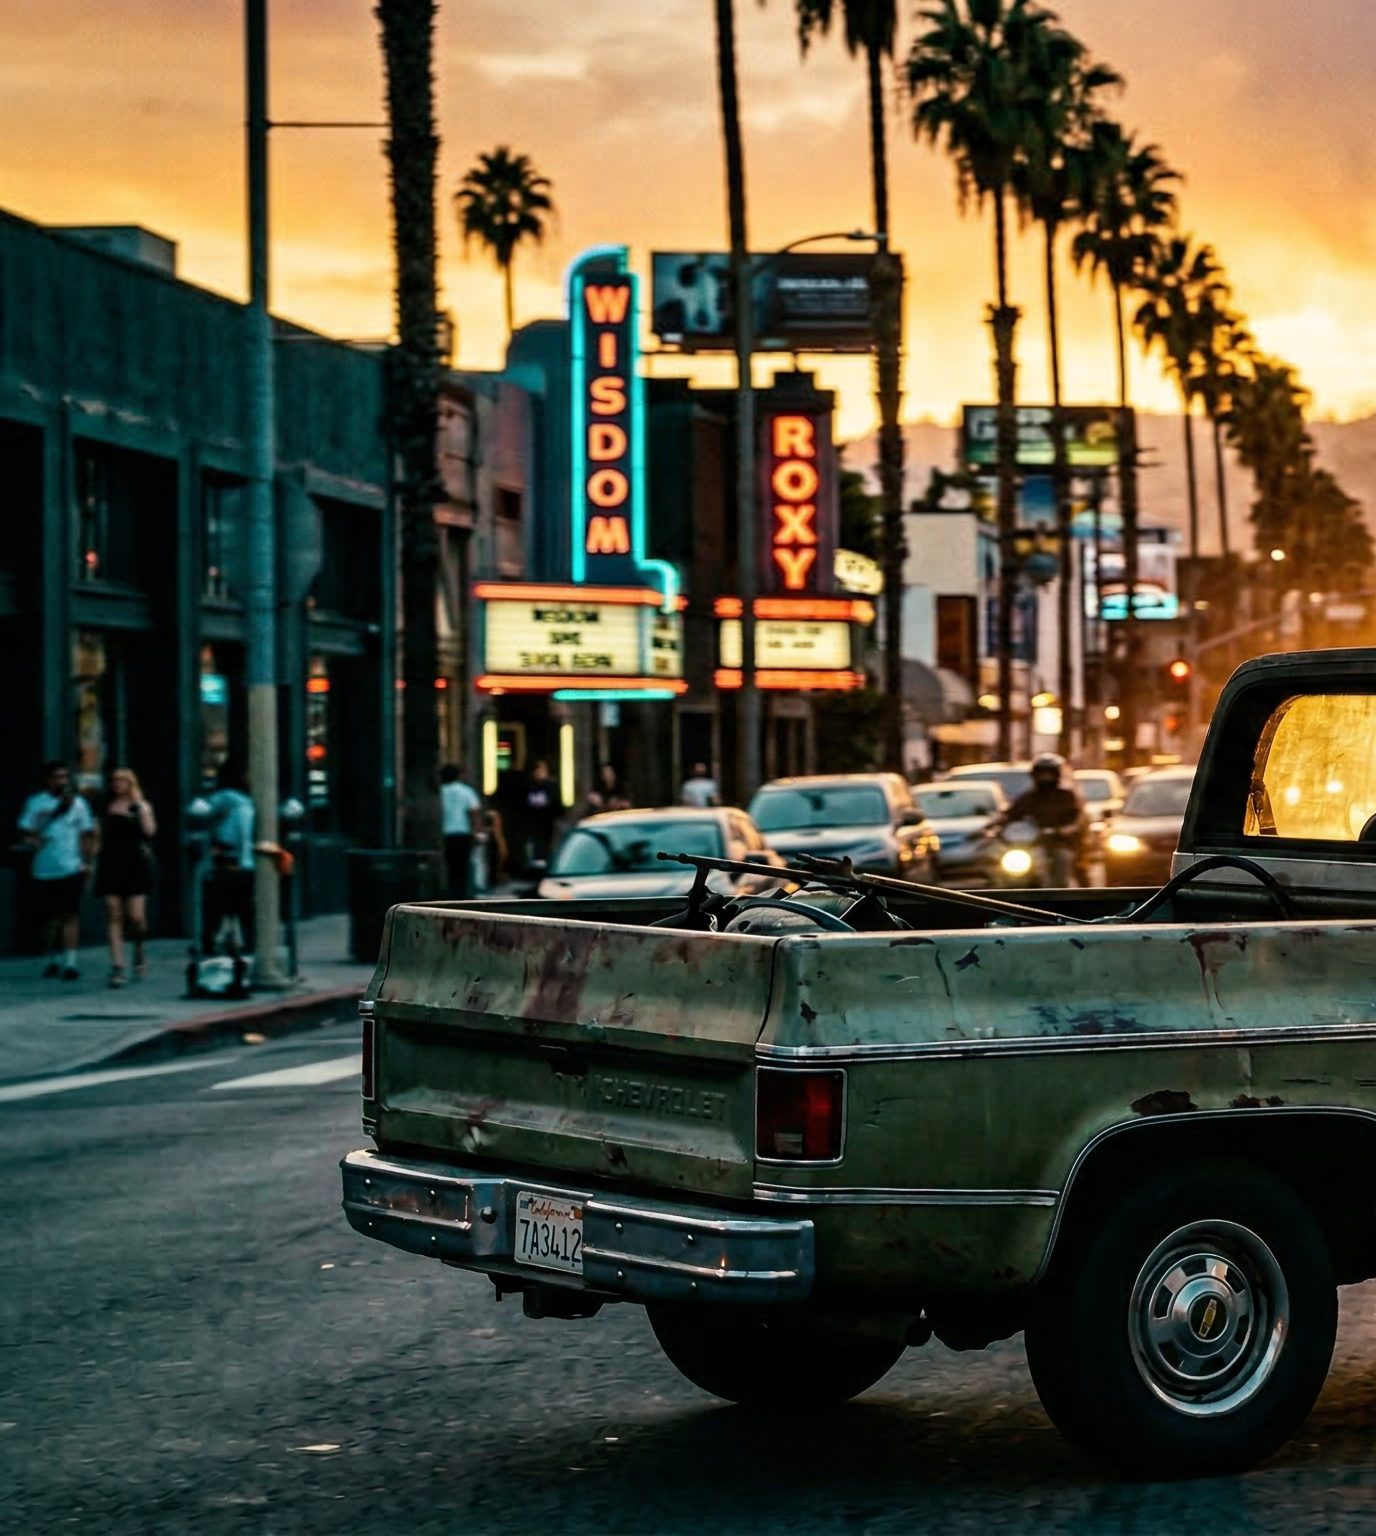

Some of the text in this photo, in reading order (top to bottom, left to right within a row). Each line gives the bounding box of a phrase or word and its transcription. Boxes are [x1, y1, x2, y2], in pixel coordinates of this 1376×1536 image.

[584, 285, 631, 554] WISDOM
[772, 415, 819, 590] ROXY
[602, 1076, 726, 1121] CHEVROLET
[519, 1218, 582, 1263] 7A3412
